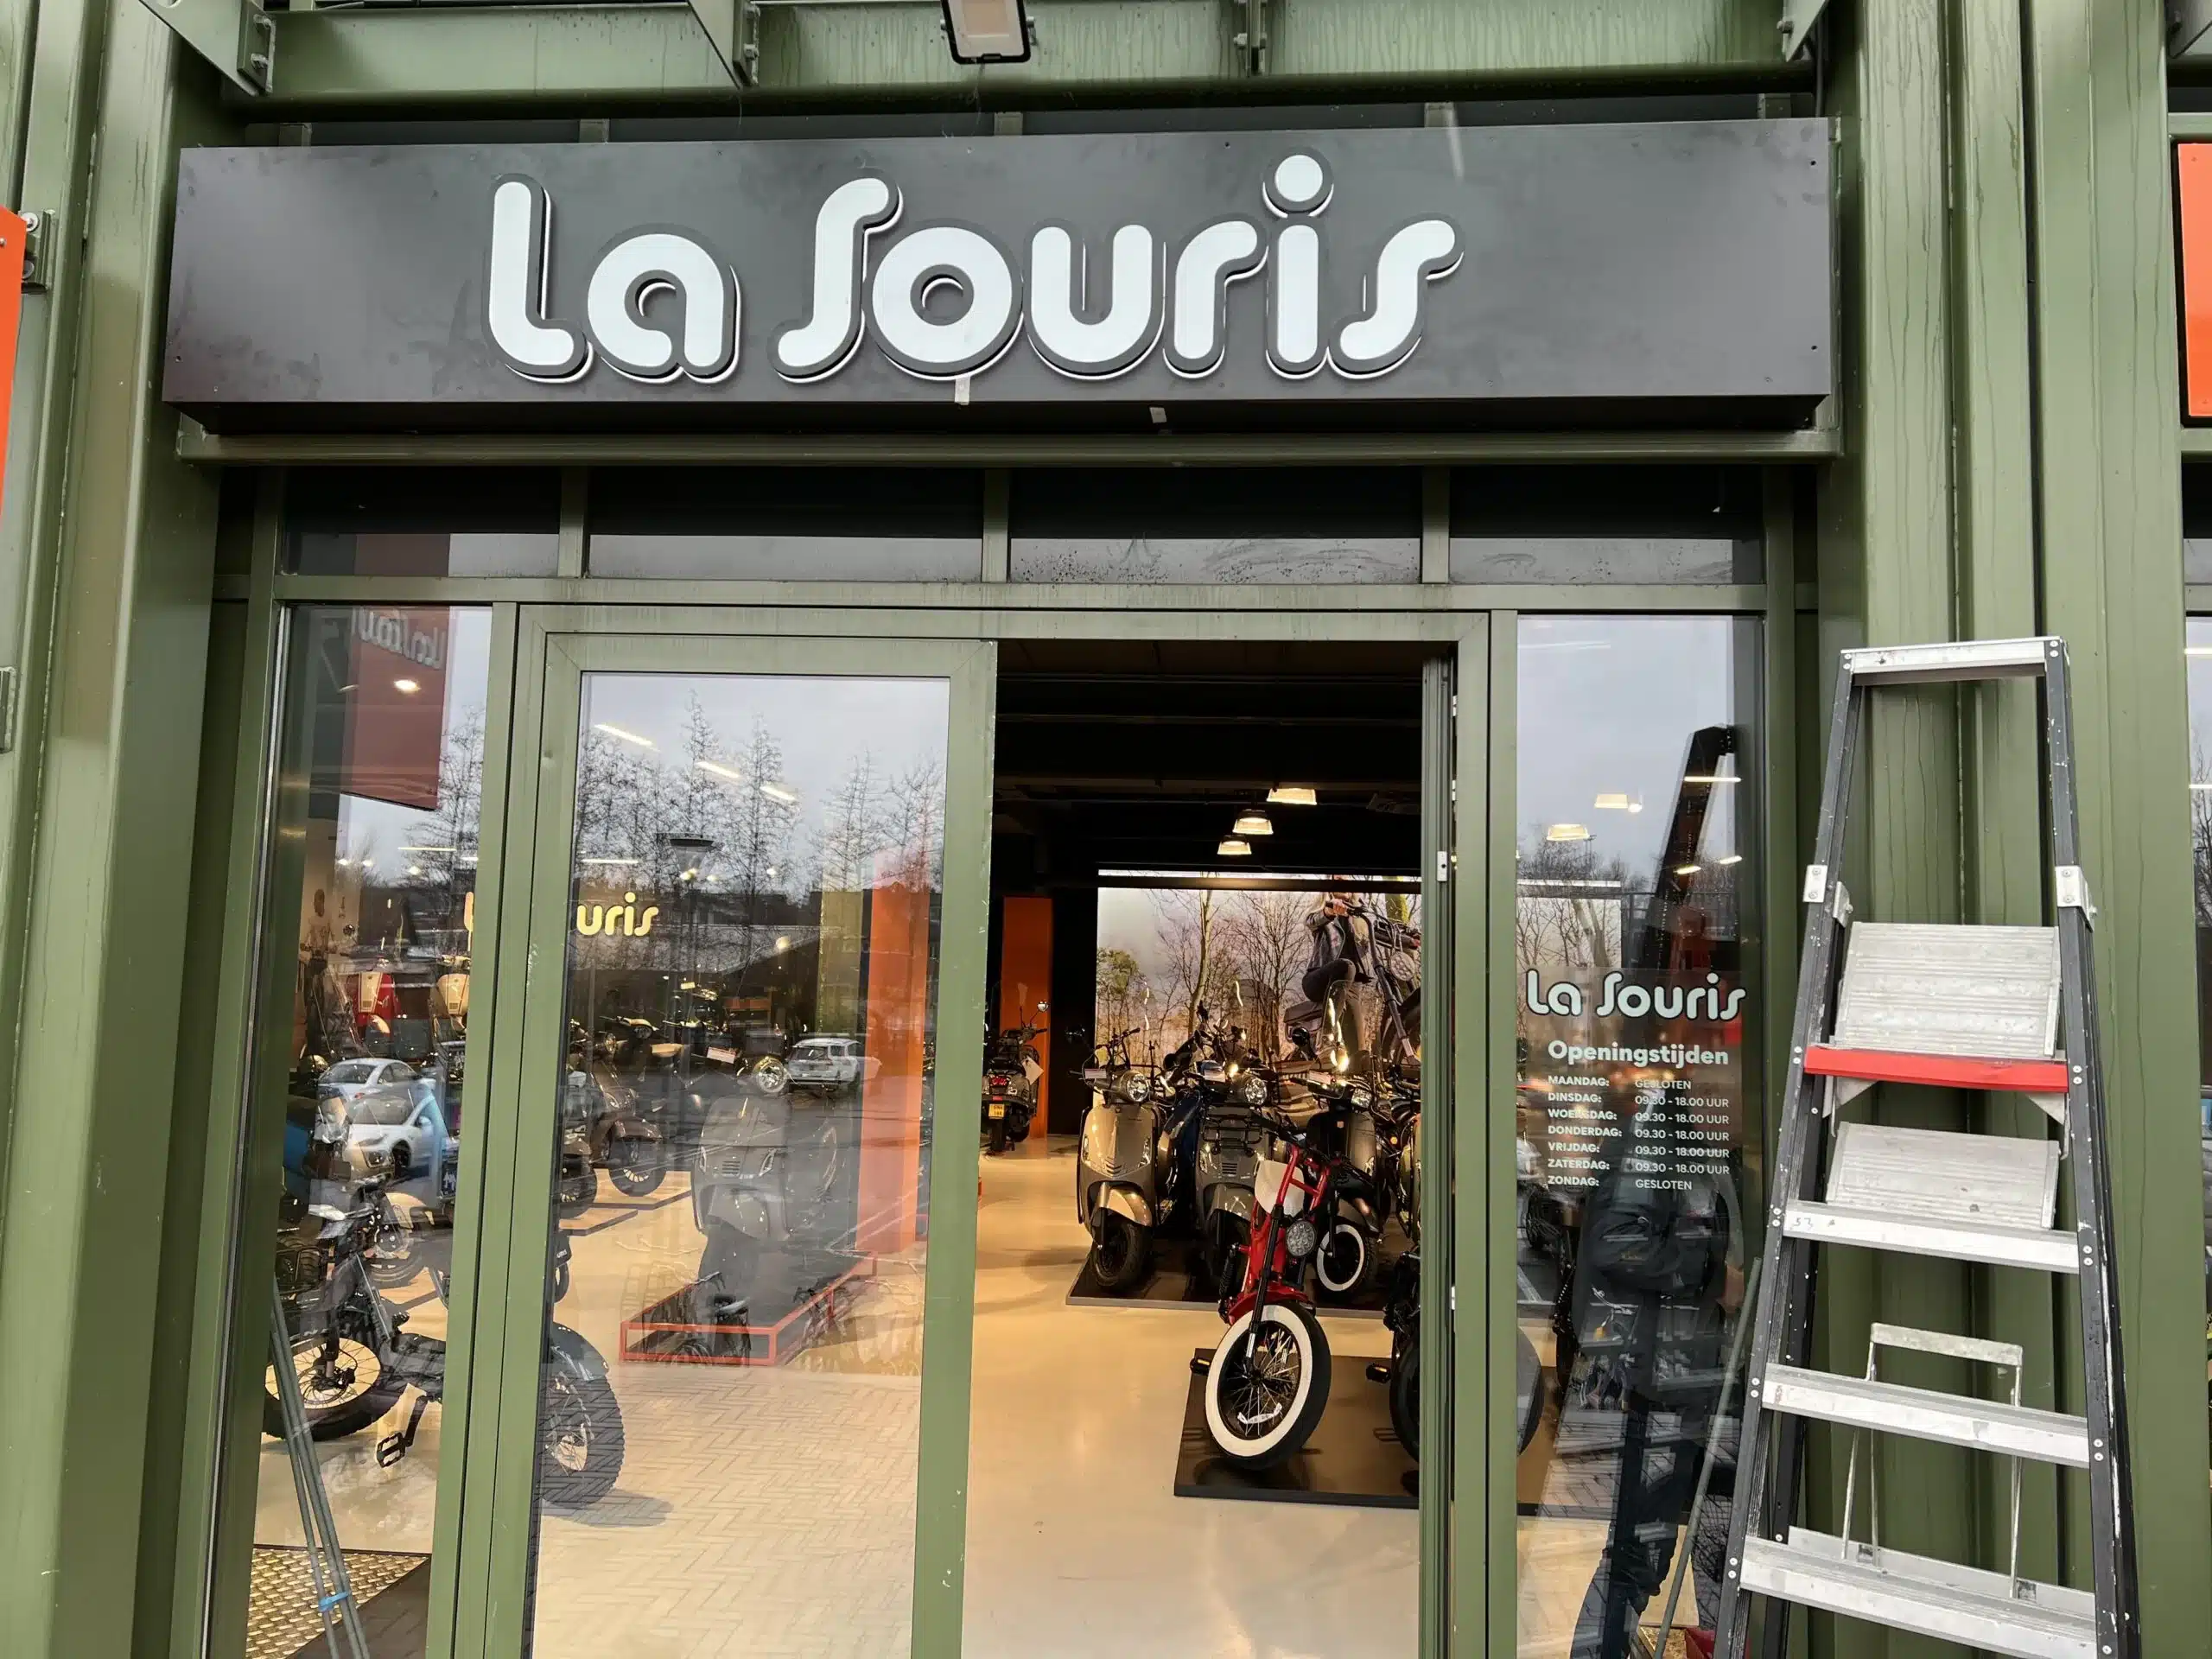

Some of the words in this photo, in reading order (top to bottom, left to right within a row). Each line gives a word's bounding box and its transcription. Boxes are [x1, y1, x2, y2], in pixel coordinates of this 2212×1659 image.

[486, 178, 738, 378] La
[775, 154, 1463, 380] Souris
[576, 892, 659, 937] uris
[1526, 969, 1583, 1016] La
[1596, 970, 1747, 1020] Souris
[1548, 1039, 1729, 1068] Openingstijden
[1548, 1075, 1610, 1087] MAANDAG:
[1635, 1080, 1692, 1090] GESLOTEN
[1548, 1092, 1602, 1103] DINSDAG:
[1635, 1096, 1666, 1105] 09.30
[1675, 1096, 1704, 1107] 18.00
[1706, 1098, 1729, 1108] UUR
[1548, 1109, 1618, 1120] WOENSDAG:
[1635, 1112, 1666, 1122] 09.30
[1675, 1113, 1704, 1124] 18.00
[1706, 1115, 1729, 1125] UUR
[1548, 1126, 1622, 1137] DONDERDAG:
[1635, 1129, 1666, 1139] 09.30
[1675, 1130, 1704, 1141] 18.00
[1706, 1132, 1729, 1141] UUR
[1548, 1142, 1600, 1153] VRIJDAG:
[1635, 1146, 1666, 1155] 09.30
[1675, 1147, 1704, 1157] 18.00
[1706, 1148, 1729, 1158] UUR
[1548, 1159, 1610, 1170] ZATERDAG:
[1635, 1162, 1666, 1173] 09.30
[1675, 1163, 1704, 1174] 18.00
[1706, 1165, 1729, 1175] UUR
[1548, 1176, 1599, 1186] ZONDAG:
[1635, 1179, 1692, 1190] GESLOTEN
